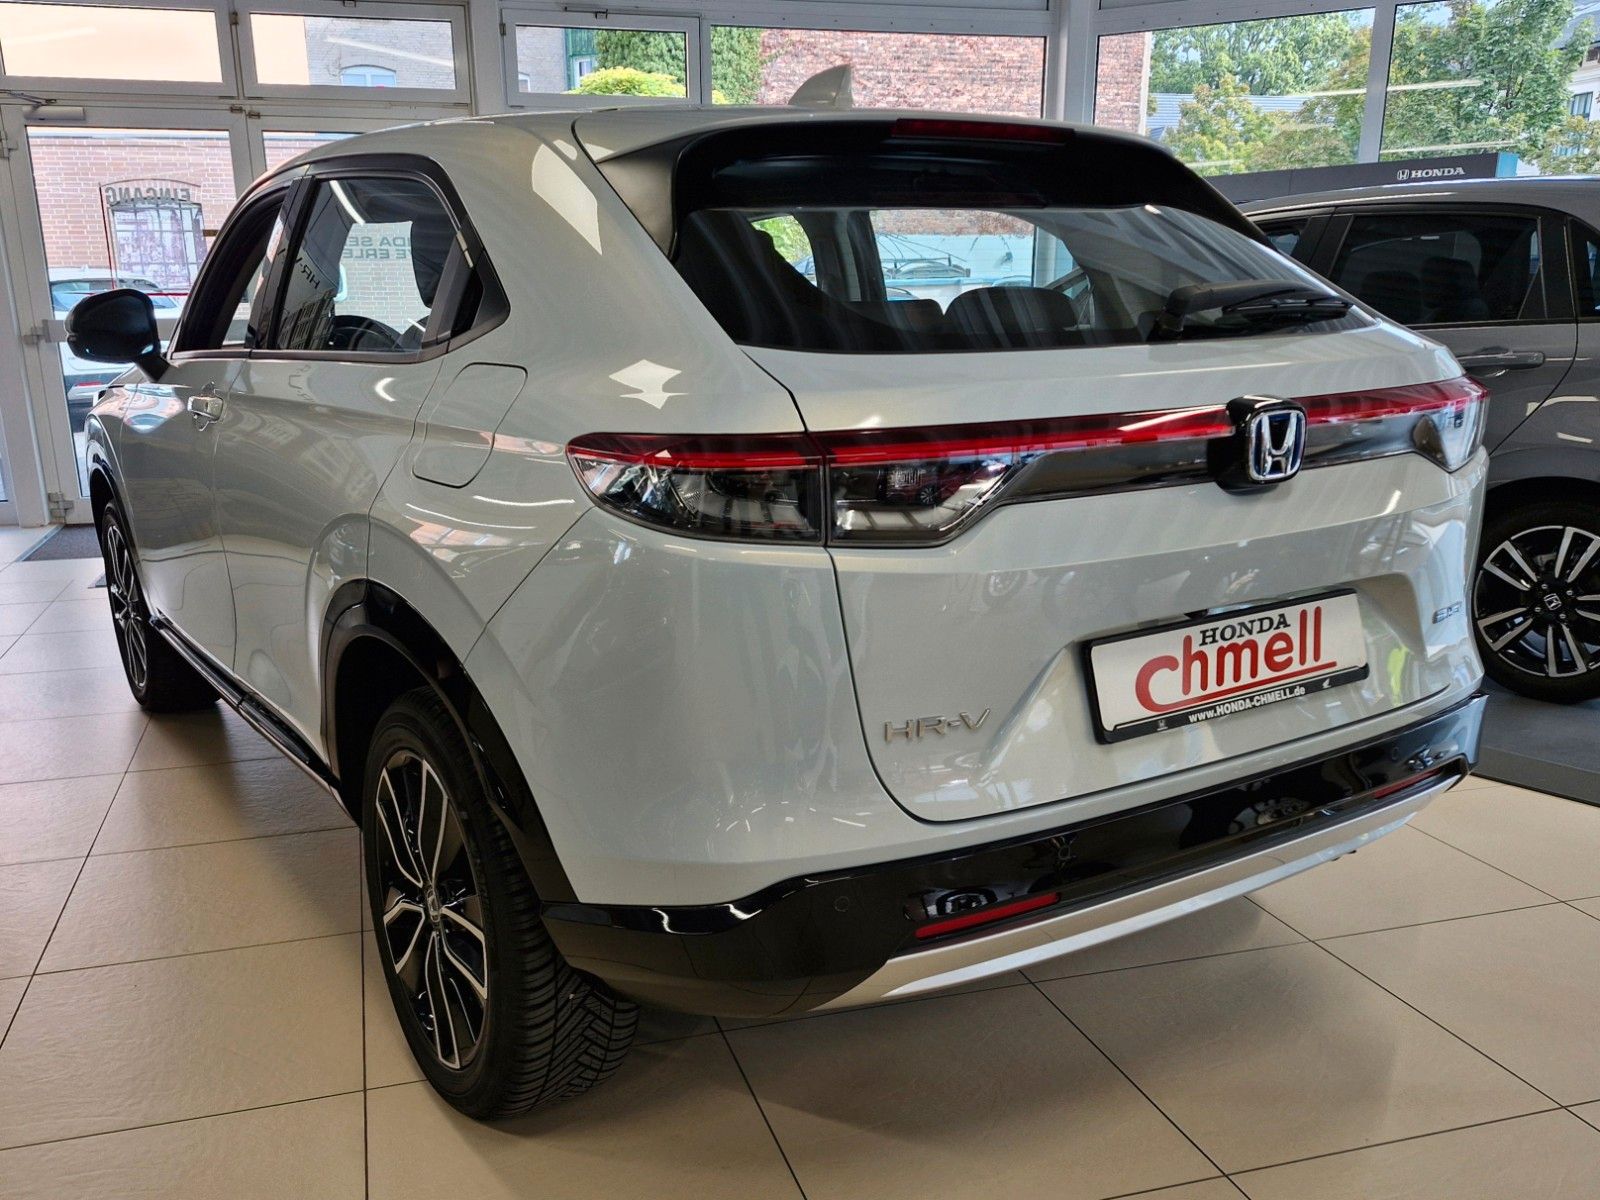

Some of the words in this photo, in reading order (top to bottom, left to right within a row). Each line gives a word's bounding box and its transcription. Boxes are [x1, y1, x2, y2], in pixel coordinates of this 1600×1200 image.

[1411, 167, 1466, 178] HONDA
[1199, 613, 1291, 646] HONDA
[1188, 685, 1306, 723] www.HONDA-CHMELL.de
[884, 708, 990, 742] HR-V
